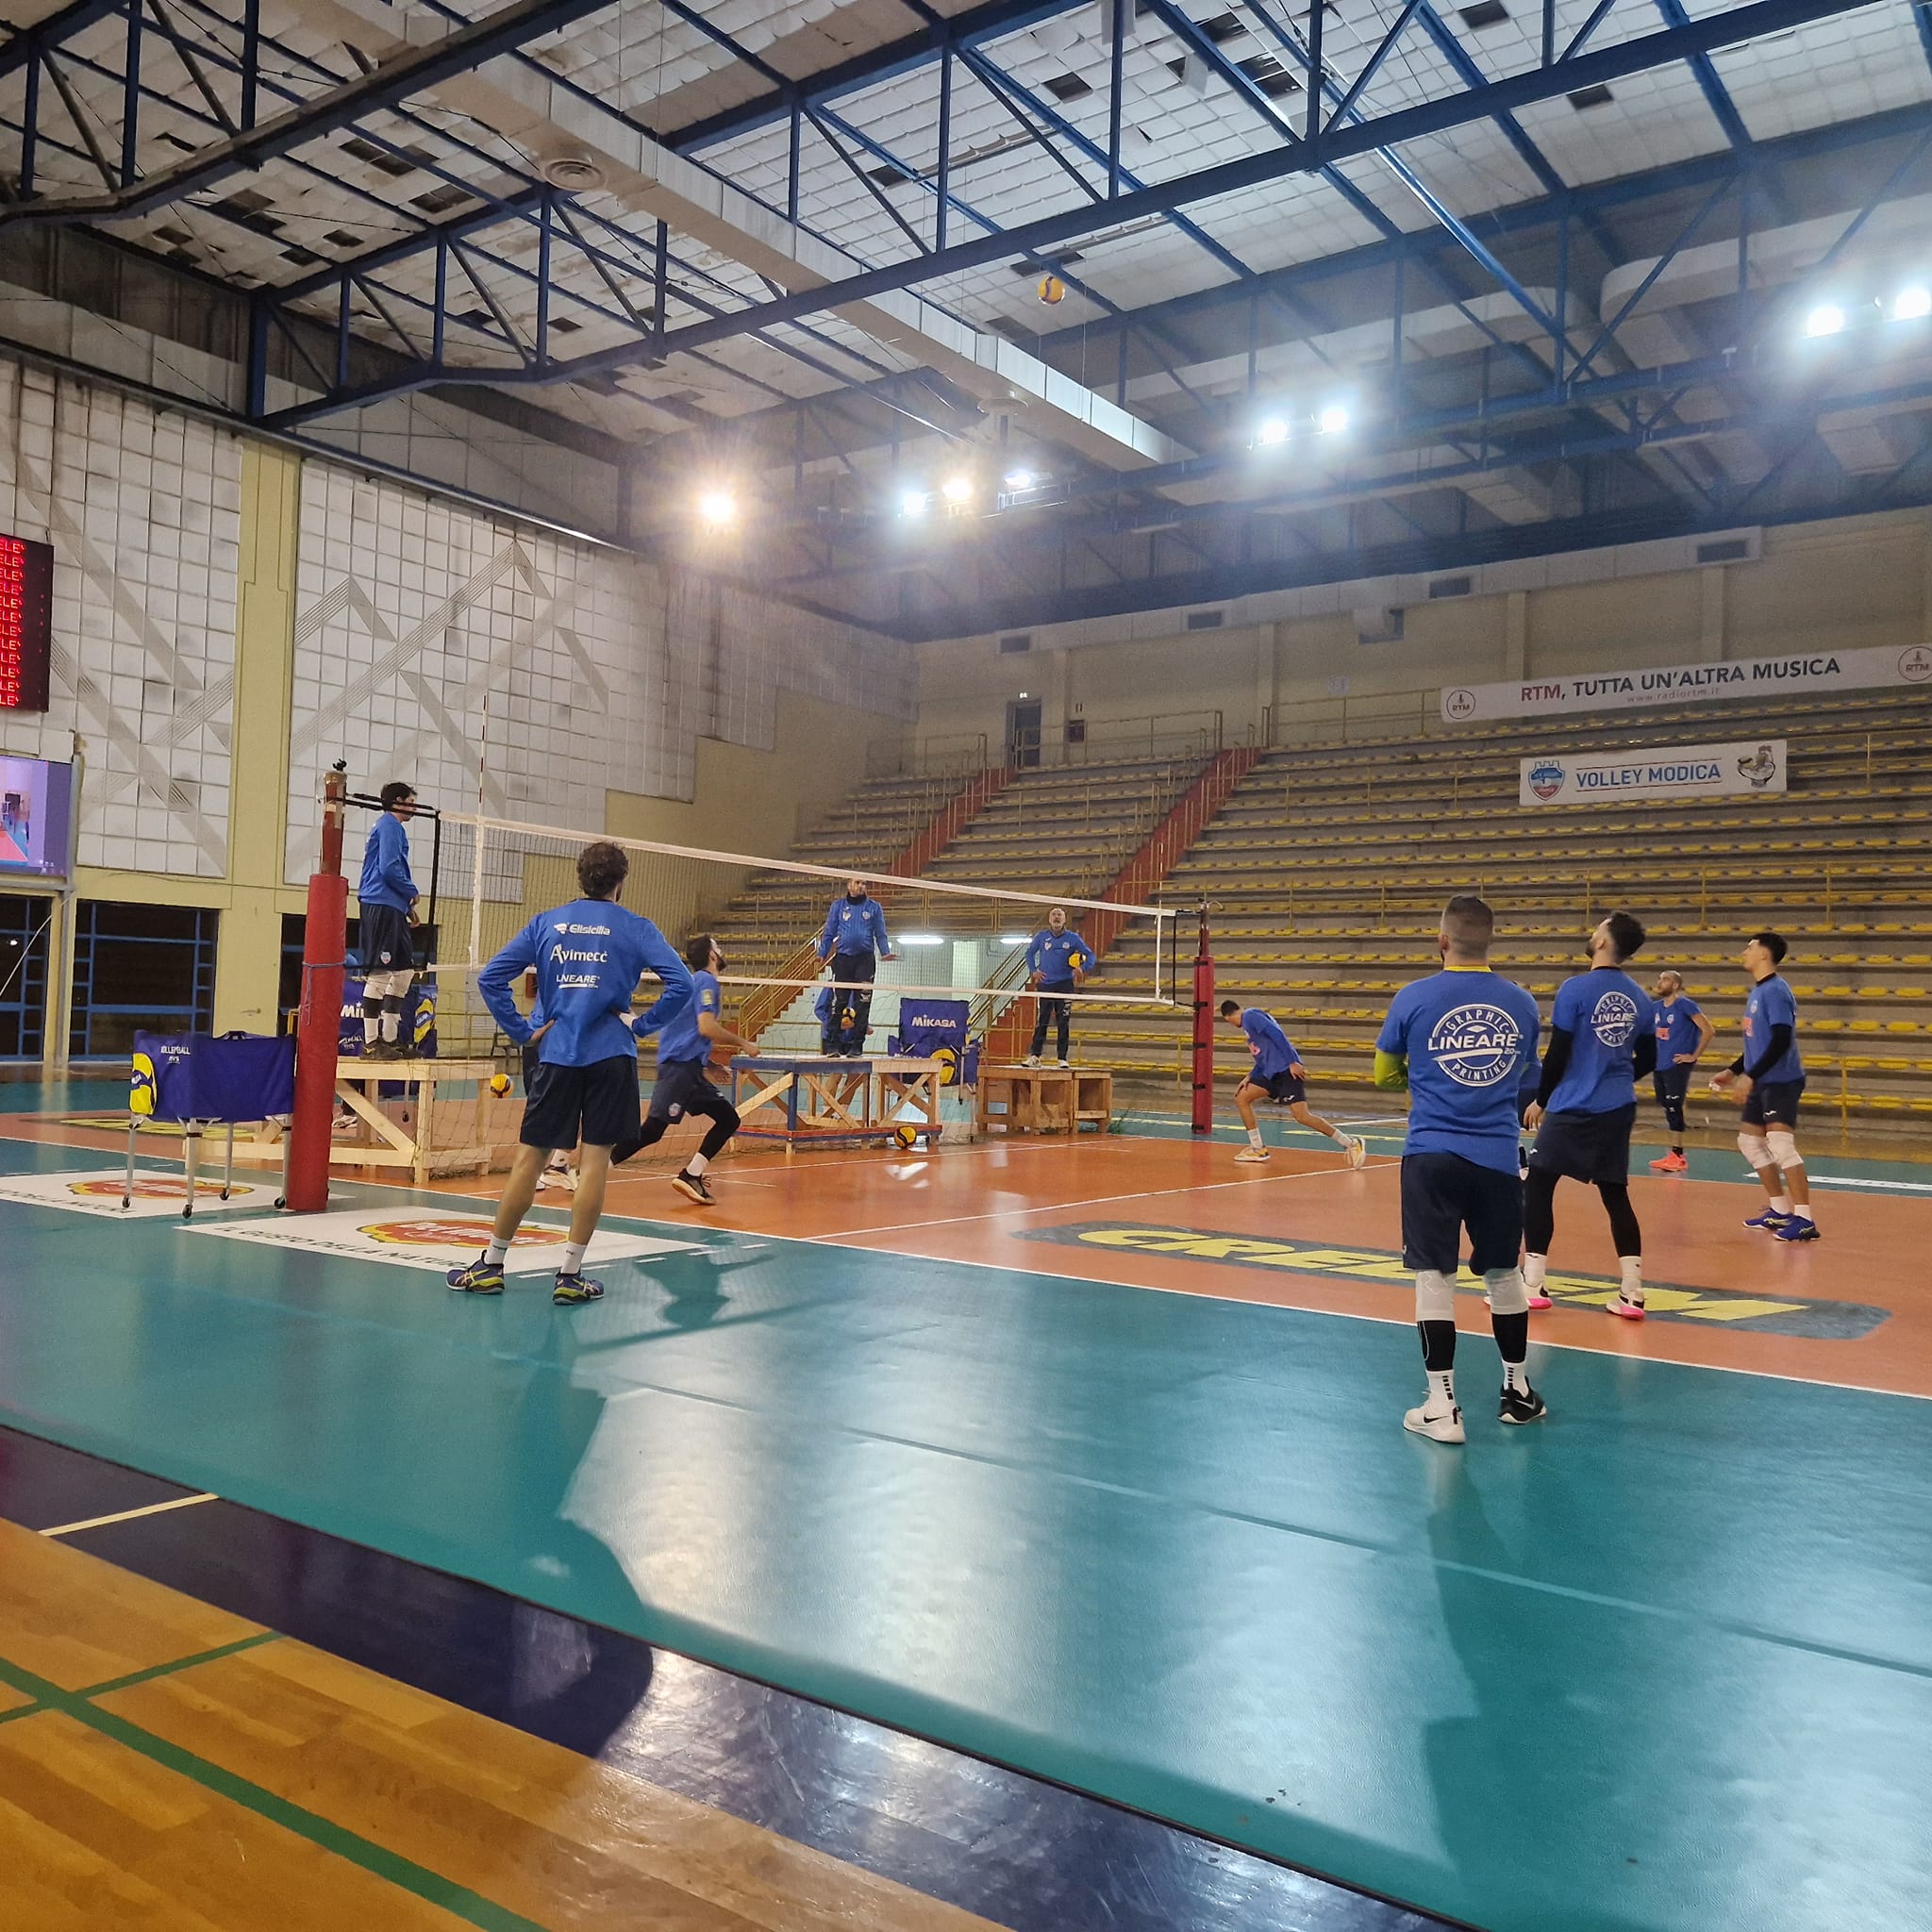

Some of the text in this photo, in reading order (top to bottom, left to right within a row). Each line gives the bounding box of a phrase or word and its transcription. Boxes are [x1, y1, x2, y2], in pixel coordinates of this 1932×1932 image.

[1522, 658, 1840, 702] RTM, TUTTA UN'ALTRA MUSICA
[1576, 763, 1722, 788] VOLLEY MODICA
[1446, 1009, 1509, 1033] GRAPHIC
[1427, 1033, 1518, 1051] LINEARE
[1452, 1059, 1507, 1080] PRINTING
